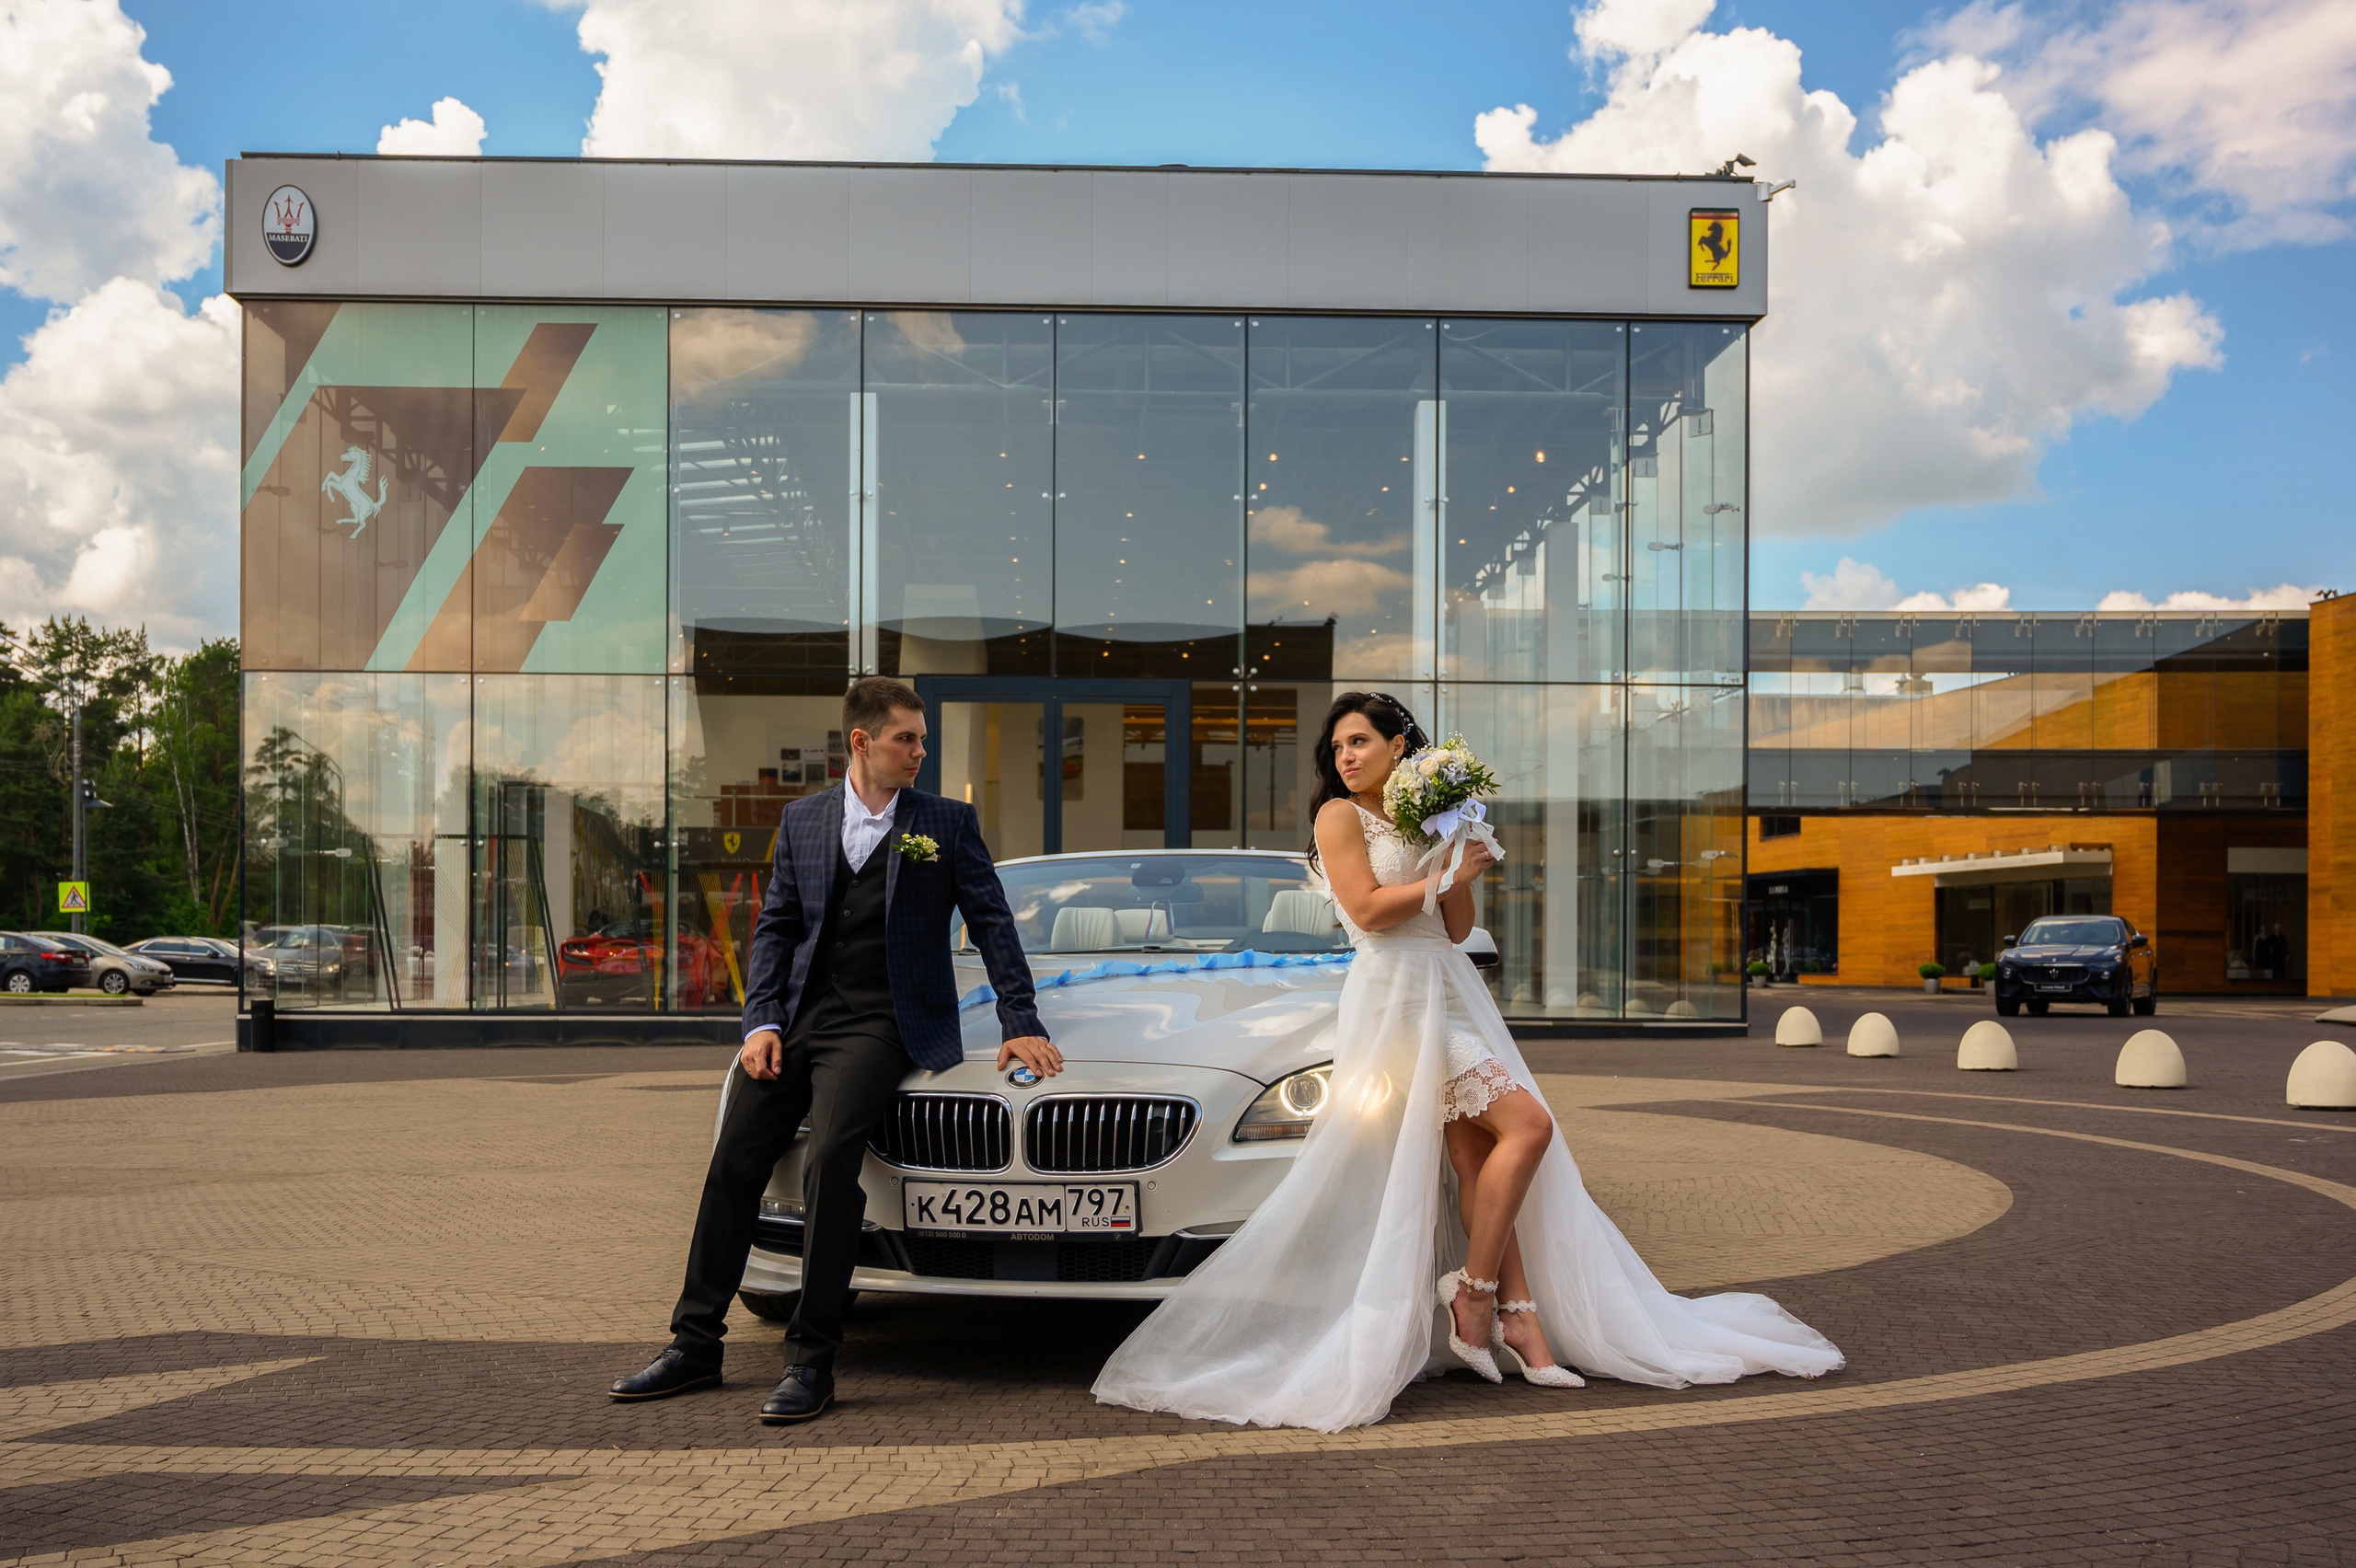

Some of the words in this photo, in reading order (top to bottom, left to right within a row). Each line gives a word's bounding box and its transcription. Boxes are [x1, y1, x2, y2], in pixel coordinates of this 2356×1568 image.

[1695, 272, 1734, 282] Ferrari
[918, 1188, 1062, 1226] K428AM
[1068, 1188, 1125, 1216] 797
[1081, 1216, 1110, 1228] RUS
